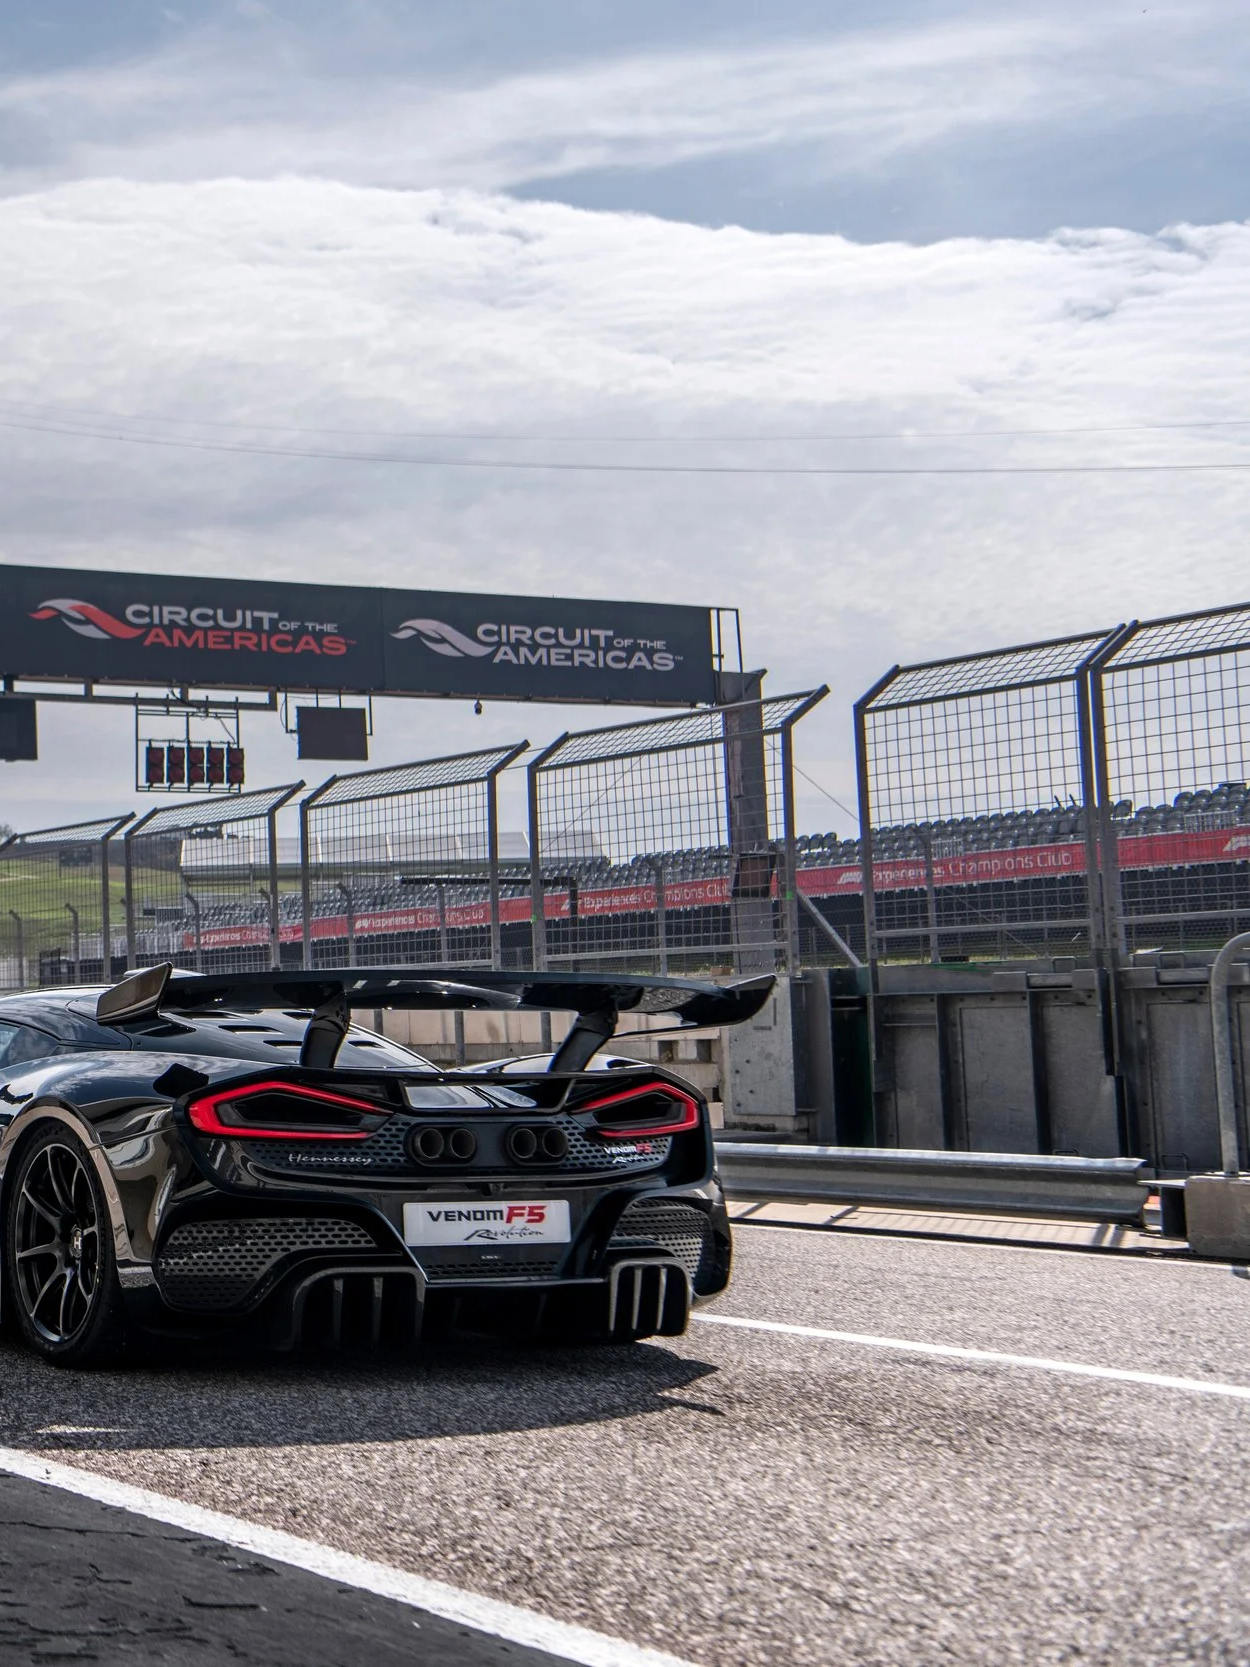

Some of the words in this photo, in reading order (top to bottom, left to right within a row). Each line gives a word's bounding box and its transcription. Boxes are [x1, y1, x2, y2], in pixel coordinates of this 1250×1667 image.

[125, 604, 279, 631] CIRCUIT
[278, 620, 300, 631] OF
[304, 622, 338, 633] THE
[476, 623, 614, 648] CIRCUIT
[613, 638, 633, 648] OF
[636, 640, 667, 650] THE
[949, 855, 1034, 877] Champons
[1037, 852, 1072, 868] Club
[643, 887, 704, 902] Chmpions
[288, 1153, 372, 1166] Hennessey
[427, 1209, 504, 1222] VENOM
[505, 1205, 548, 1224] F5
